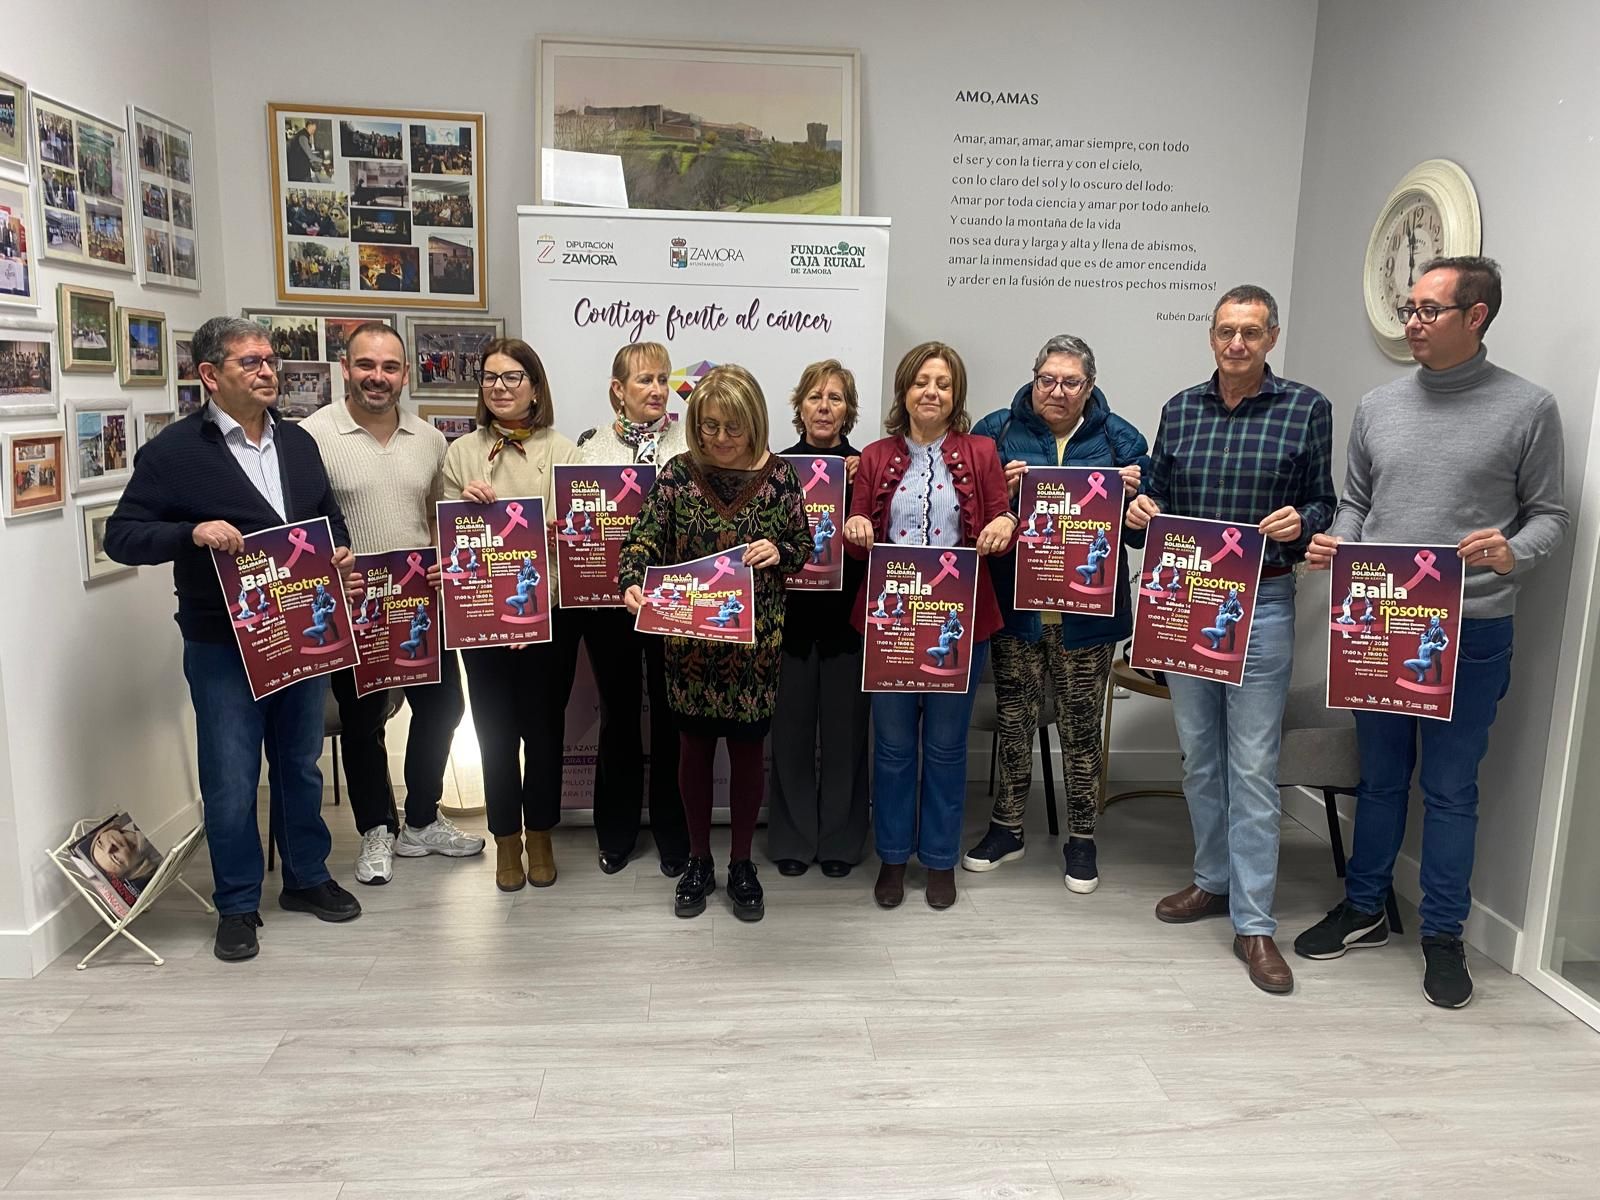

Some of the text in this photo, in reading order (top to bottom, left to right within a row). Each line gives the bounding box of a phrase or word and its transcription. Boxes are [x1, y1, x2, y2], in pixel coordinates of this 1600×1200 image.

[954, 134, 1189, 152] Amar, amar, amar, amar siempre, con todo
[953, 154, 963, 164] el
[986, 157, 993, 168] y
[996, 158, 1016, 166] con
[1020, 156, 1029, 166] la
[1033, 156, 1063, 168] tierra
[1066, 160, 1073, 171] y
[1100, 158, 1109, 170] el
[1112, 160, 1142, 172] cielo,
[952, 176, 973, 184] con
[977, 174, 987, 185] lo
[990, 175, 1018, 186] claro
[1022, 176, 1039, 187] del
[1042, 177, 1058, 187] sol
[1061, 180, 1067, 191] y
[1070, 178, 1080, 188] lo
[1084, 181, 1122, 190] oscuro
[1126, 180, 1142, 190] del
[951, 195, 1210, 213] Amar por toda ciencia y amar por todo anhelo.
[950, 215, 1120, 230] Y cuando la montaña de la vida
[950, 237, 969, 245] nos
[994, 236, 1019, 246] dura
[1022, 239, 1029, 249] y
[1032, 236, 1058, 250] larga
[1061, 240, 1068, 250] y
[1070, 238, 1090, 248] alta
[1093, 241, 1099, 252] y
[1102, 238, 1128, 250] llena
[1131, 240, 1144, 250] de
[1148, 240, 1196, 252] abismos,
[562, 253, 617, 266] ZAMORA
[690, 248, 744, 261] ZAMORA
[791, 256, 865, 268] CAJA RURAL
[980, 254, 989, 265] la
[992, 255, 1057, 267] inmensidad
[1060, 260, 1081, 270] que
[1100, 258, 1112, 268] de
[1148, 260, 1206, 271] encendida
[1385, 256, 1395, 278] 9
[948, 276, 956, 287] ¡y
[960, 274, 990, 284] arder
[1009, 275, 1018, 285] la
[1022, 275, 1054, 286] fusión
[1058, 276, 1071, 287] de
[1074, 278, 1123, 288] nuestros
[1126, 278, 1166, 291] pechos
[1170, 280, 1216, 291] mismos!
[574, 298, 831, 343] Contigo frente al cáncer
[1156, 312, 1186, 320] Rubén
[1037, 483, 1064, 491] GALA
[572, 489, 617, 512] Baila
[805, 503, 835, 513] otros
[1036, 492, 1081, 515] Baila
[455, 516, 484, 524] GALA
[596, 515, 636, 541] nosotr
[456, 525, 504, 549] Baila
[1058, 520, 1111, 544] nosotros
[1165, 533, 1195, 544] GALA
[236, 550, 266, 565] GALA
[482, 550, 537, 577] nosotros
[887, 562, 915, 570] GALA
[1162, 546, 1212, 572] Baila
[1352, 562, 1386, 571] GALA
[241, 557, 291, 591] Baila
[368, 566, 388, 577] GALA
[367, 574, 402, 600] Baila
[886, 572, 932, 595] Baila
[1185, 575, 1246, 602] nosotros
[1351, 573, 1408, 599] Baila
[269, 576, 330, 612] nosotros
[383, 596, 429, 624] nosotros
[909, 600, 964, 626] nosotros
[1380, 605, 1448, 634] nosotros
